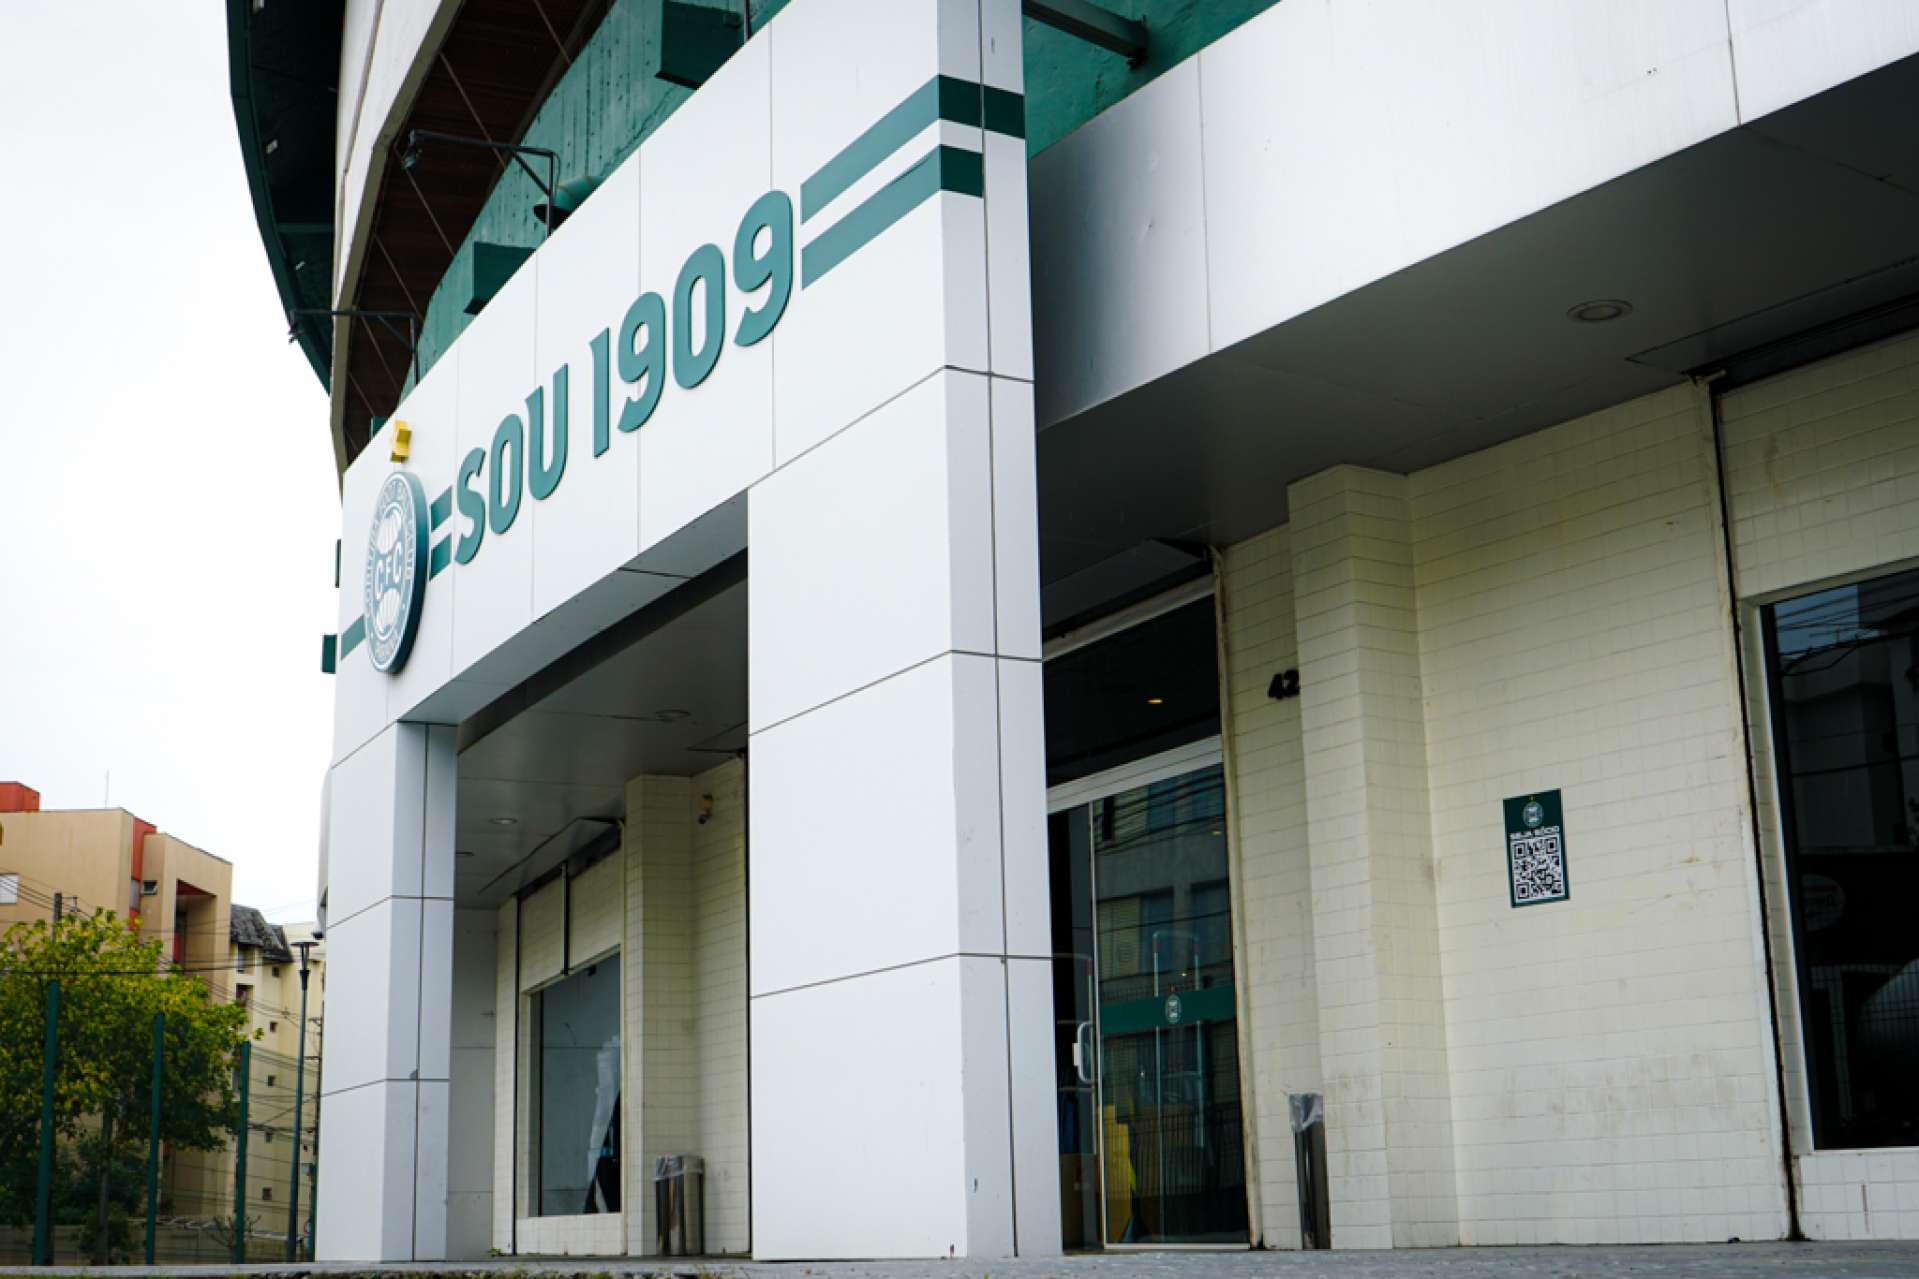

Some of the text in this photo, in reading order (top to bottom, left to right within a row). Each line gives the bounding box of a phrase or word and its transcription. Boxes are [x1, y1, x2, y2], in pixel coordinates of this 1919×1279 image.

[454, 189, 794, 566] SOU 1909
[374, 541, 402, 601] CFC
